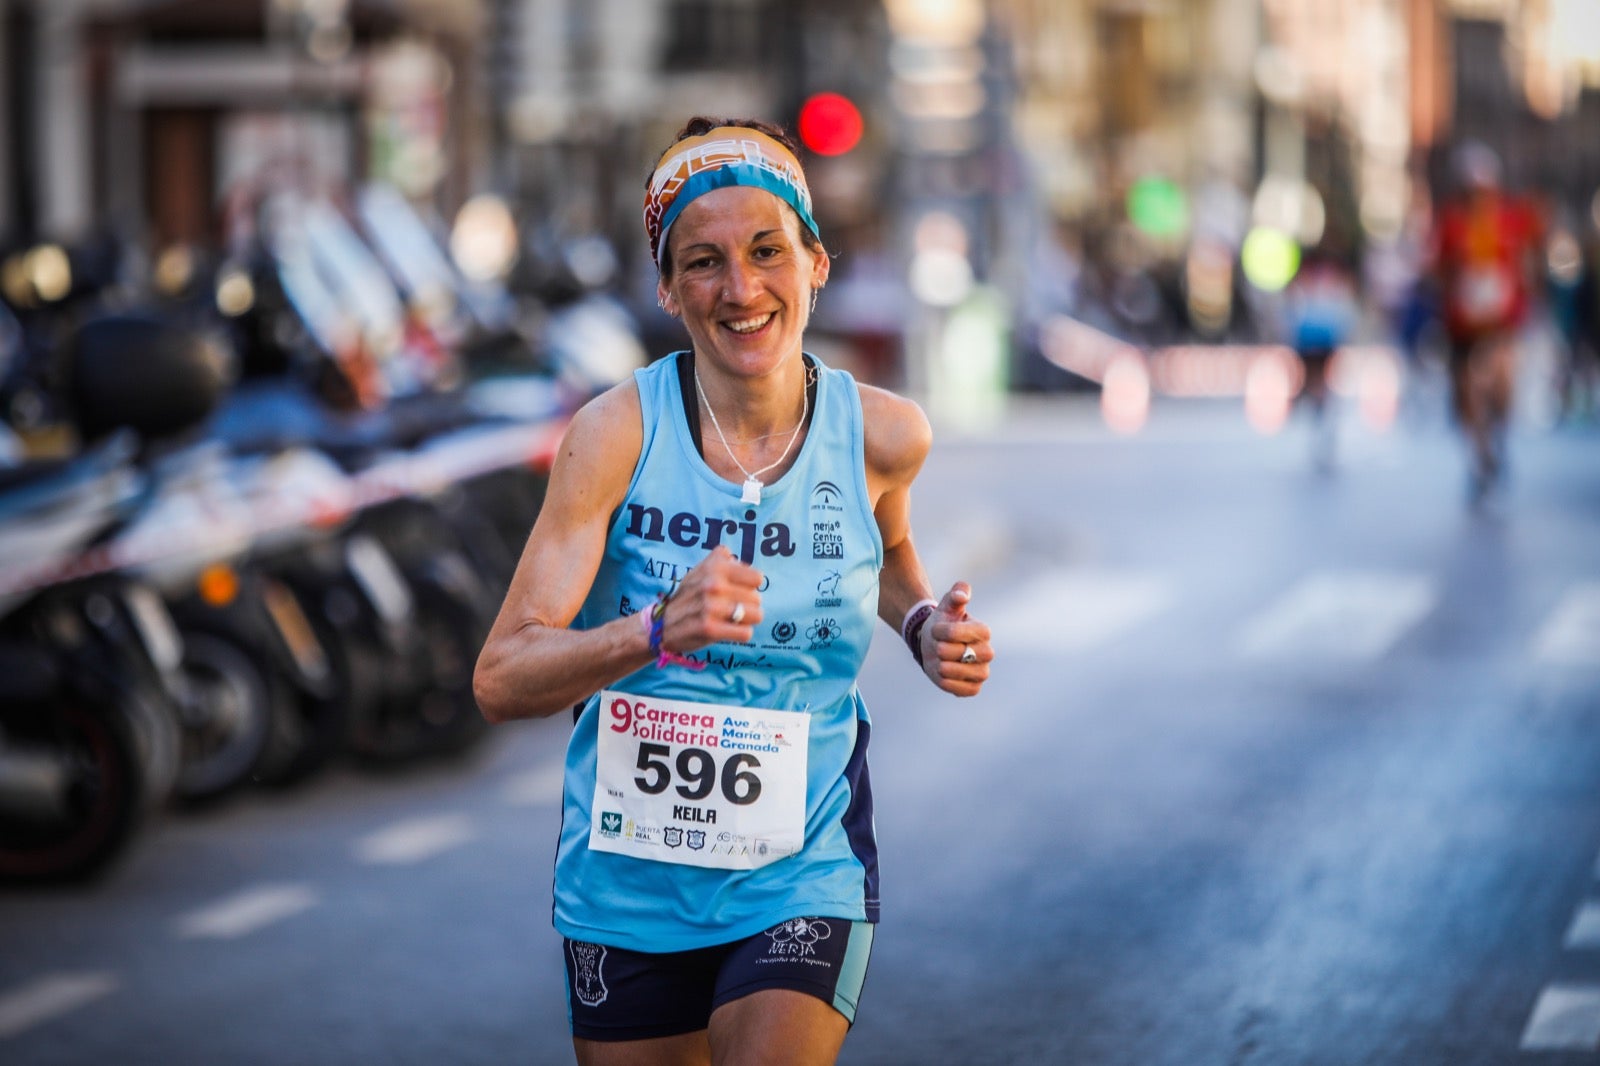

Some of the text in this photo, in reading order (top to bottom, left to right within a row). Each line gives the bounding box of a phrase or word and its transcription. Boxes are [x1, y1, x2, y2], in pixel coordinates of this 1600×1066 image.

[625, 503, 796, 566] nerja
[813, 532, 842, 542] Centro
[611, 698, 715, 733] 9 Carrera
[723, 716, 750, 728] Ave
[632, 720, 719, 748] Solidaria
[720, 739, 779, 753] Granada
[634, 742, 762, 806] 596
[673, 805, 717, 824] KEILA
[636, 832, 651, 840] REAL
[768, 942, 816, 957] NERJA
